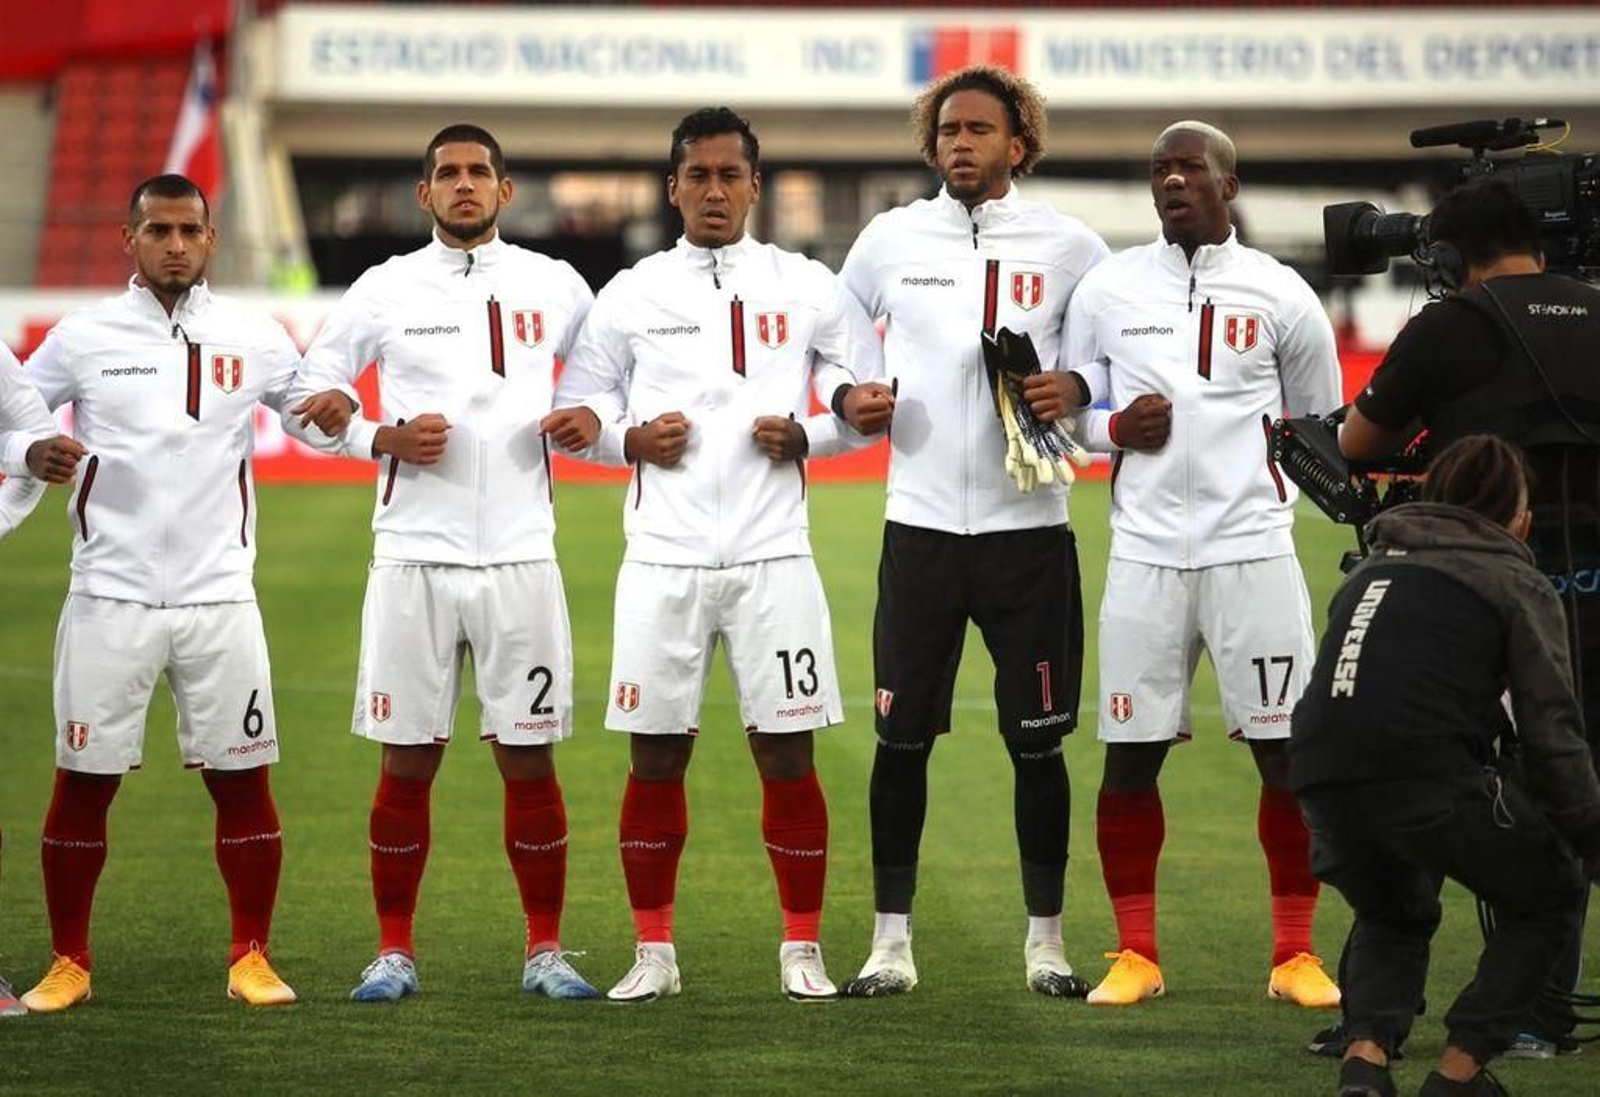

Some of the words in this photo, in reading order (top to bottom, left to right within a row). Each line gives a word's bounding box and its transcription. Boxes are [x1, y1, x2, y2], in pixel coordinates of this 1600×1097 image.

[312, 35, 507, 76] ESTADIO
[513, 36, 748, 77] NACIONAL
[1045, 36, 1316, 79] MINISTERIO
[1322, 36, 1408, 80] DEL
[901, 277, 955, 287] marathon
[405, 325, 460, 337] marathon
[647, 325, 701, 336] marathon
[1121, 325, 1174, 337] marathon
[101, 366, 157, 378] marathon
[1331, 579, 1392, 698] UNIVERSE
[527, 665, 554, 716] 2
[776, 648, 818, 699] 13
[1037, 661, 1053, 712] 1
[1252, 655, 1294, 707] 17
[242, 688, 264, 739] 6
[1021, 712, 1072, 728] marathon
[1250, 713, 1292, 724] marath
